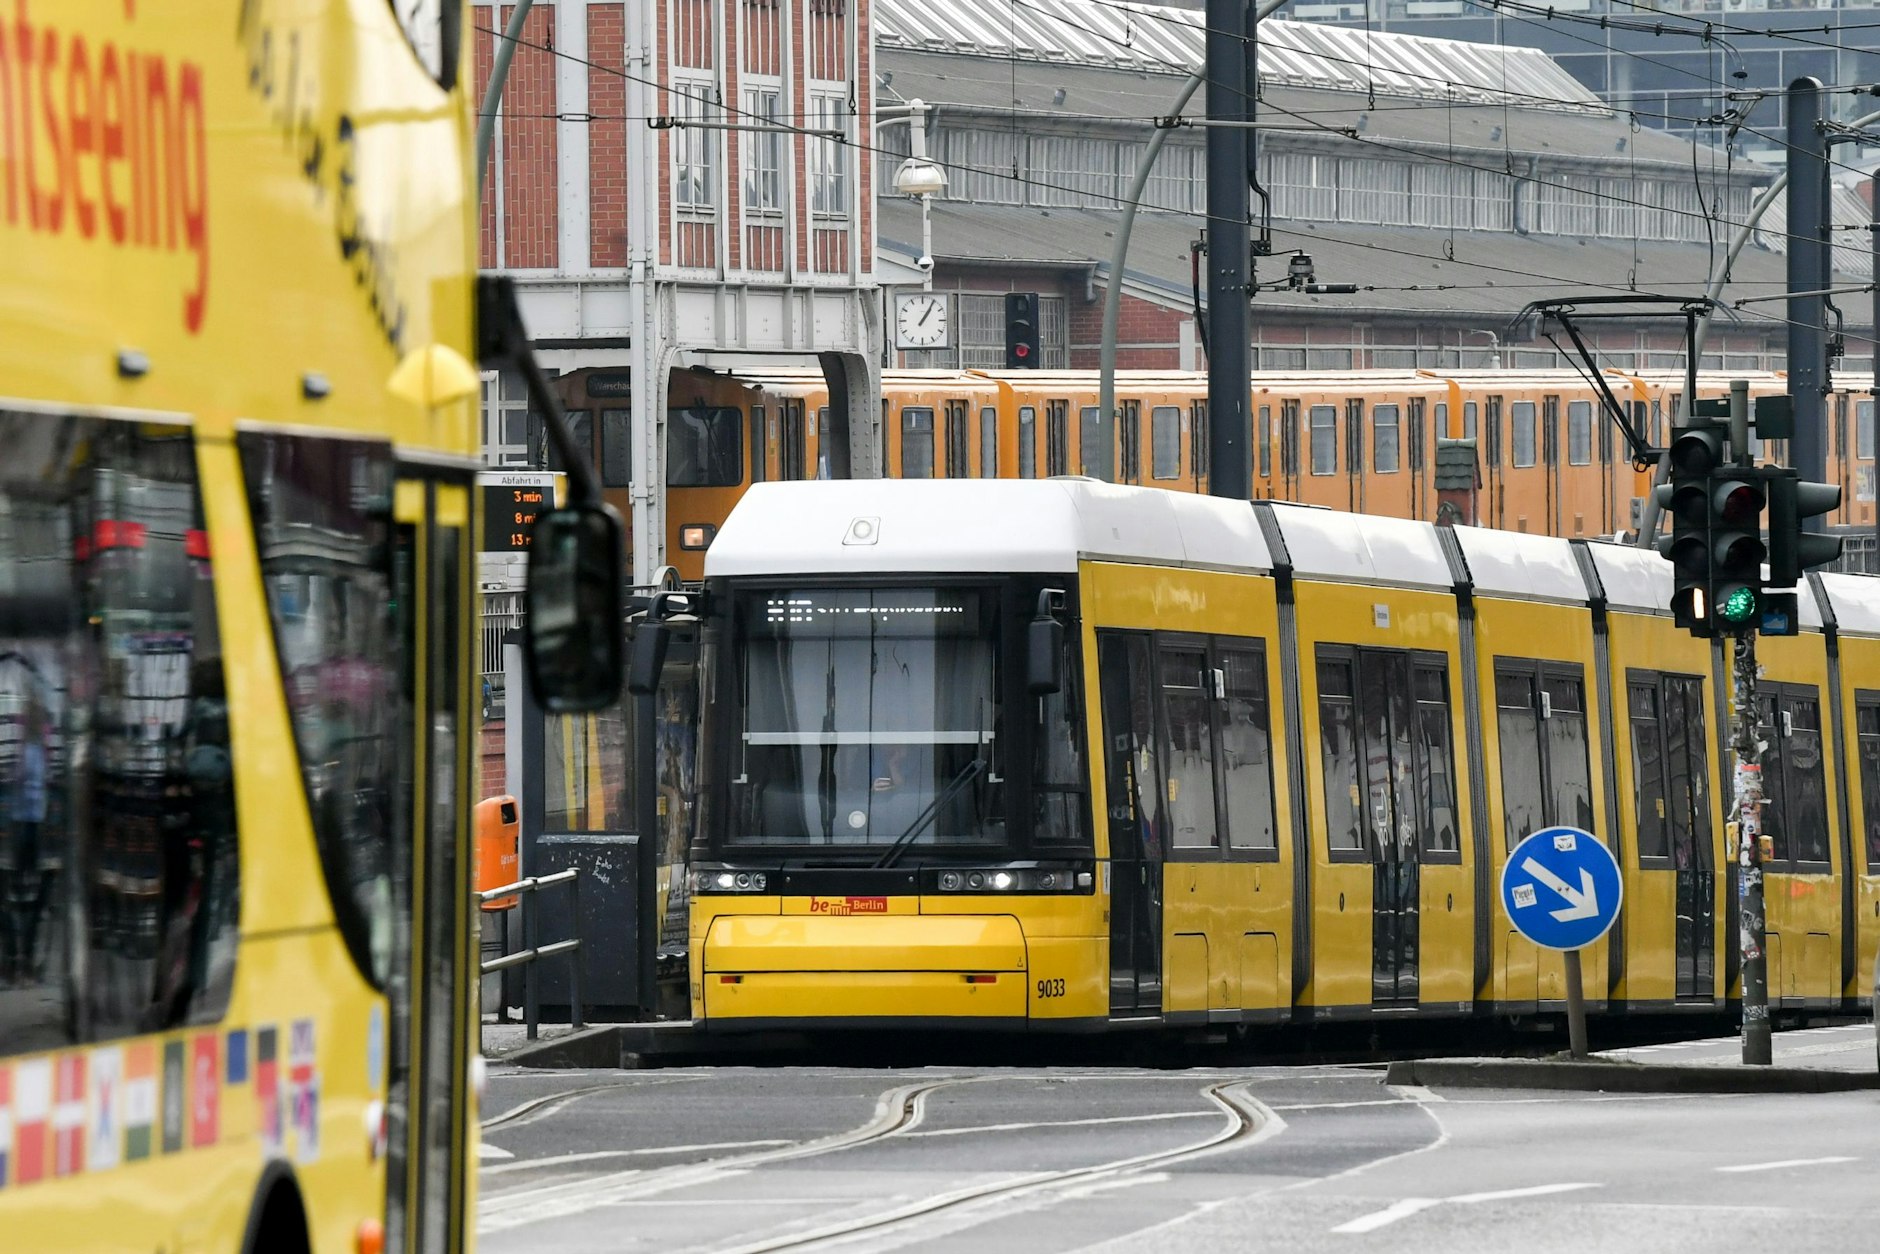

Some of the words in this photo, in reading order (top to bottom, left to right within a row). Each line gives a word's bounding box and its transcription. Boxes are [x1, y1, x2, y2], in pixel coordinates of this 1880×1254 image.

[513, 490, 522, 502] 3
[523, 491, 542, 502] min
[514, 512, 522, 524] 8
[511, 533, 524, 545] 13
[810, 896, 829, 912] be
[853, 900, 884, 910] Berlin
[1037, 978, 1065, 999] 9033
